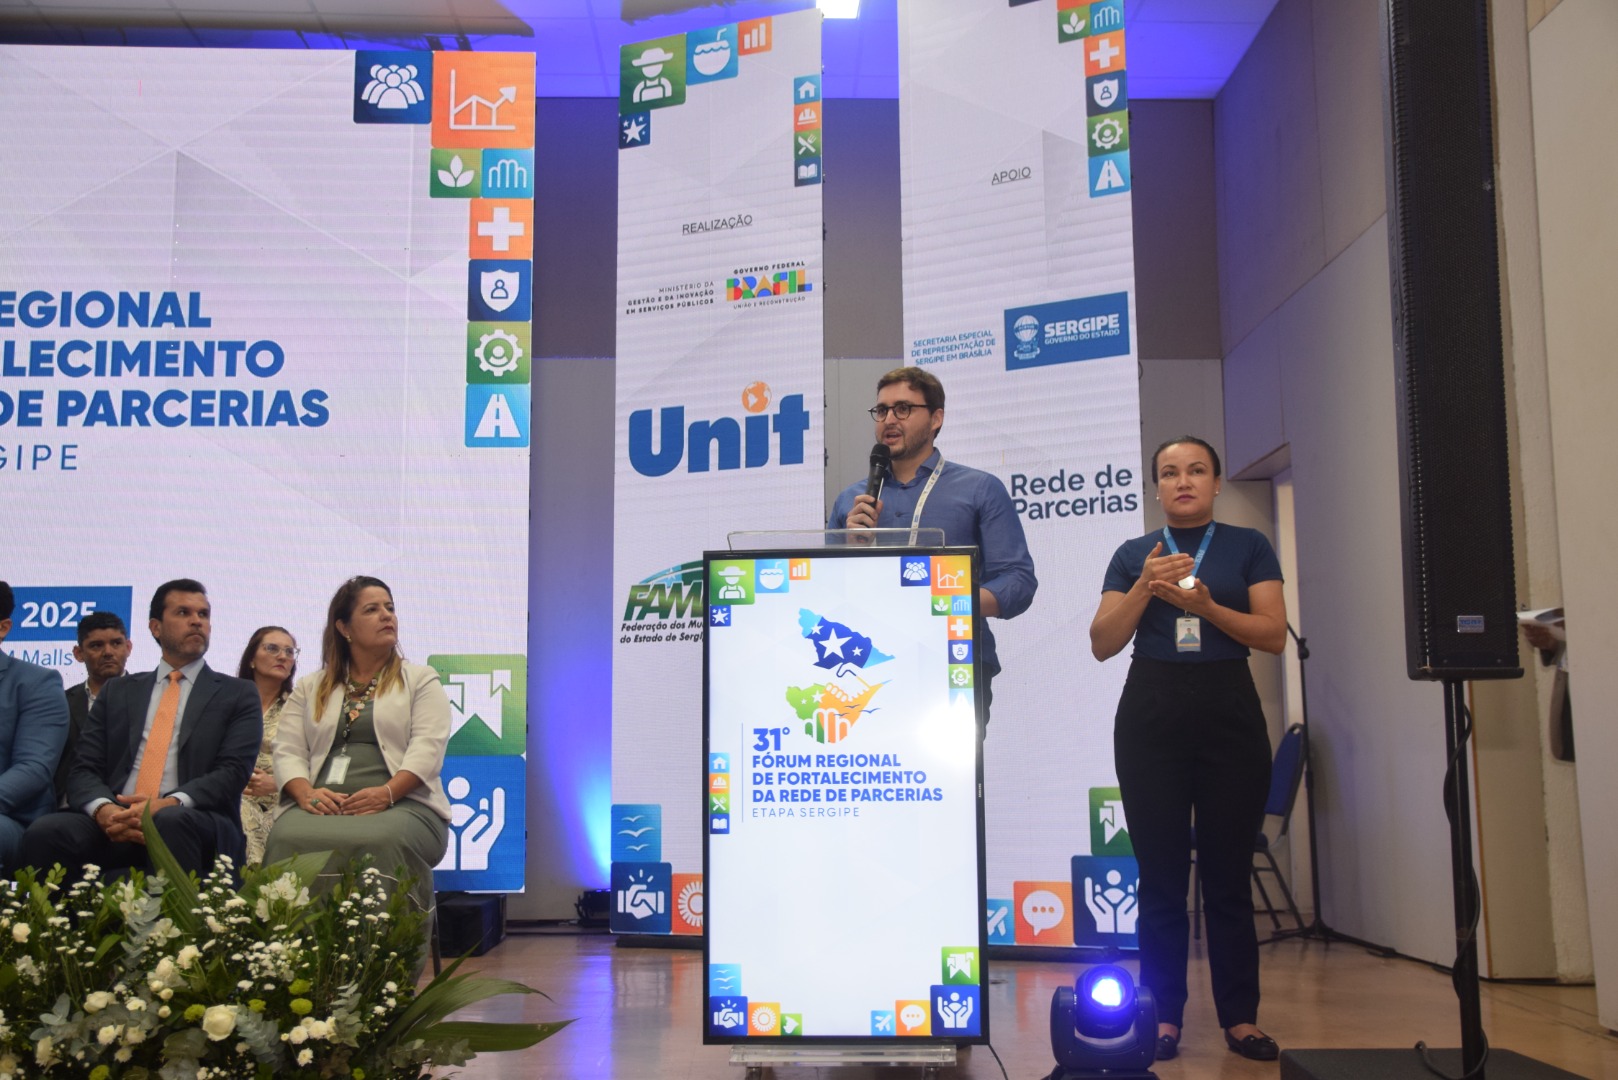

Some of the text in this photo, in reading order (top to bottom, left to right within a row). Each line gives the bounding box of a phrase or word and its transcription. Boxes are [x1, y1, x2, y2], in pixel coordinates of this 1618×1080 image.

[991, 166, 1031, 184] APOIO
[682, 214, 753, 235] REALIZAÇÃO
[734, 261, 805, 275] GOVERNO FEDERAL
[726, 269, 813, 302] BRASIL
[628, 297, 655, 306] GESTÃO
[676, 289, 714, 300] INOVAÇÃO
[639, 304, 674, 313] SERVIÇOS
[677, 298, 714, 308] PÚBLICOS
[1044, 313, 1120, 338] SERGIPE
[913, 330, 993, 348] SECRETARIA ESPECIAL
[1044, 334, 1078, 345] GOVERNO
[1091, 329, 1120, 338] ESTADO
[911, 349, 922, 357] DE
[922, 340, 984, 355] REPRESENTAÇÃO
[915, 355, 945, 365] SERGIPE
[57, 389, 330, 427] PARCERIAS
[628, 381, 810, 477] Unit
[1011, 464, 1133, 497] Rede de
[1012, 490, 1138, 520] Parcerias
[21, 601, 97, 628] 2025
[621, 619, 703, 632] Federação dos Mu
[620, 631, 703, 644] do Estado de Sergi
[23, 649, 73, 666] Malls
[752, 752, 901, 768] FÓRUM REGIONAL
[752, 770, 927, 785] DE FORTALECIMENTO
[752, 787, 943, 803] DA REDE DE PARCERIAS
[752, 807, 860, 818] ETAPA SERGIPE
